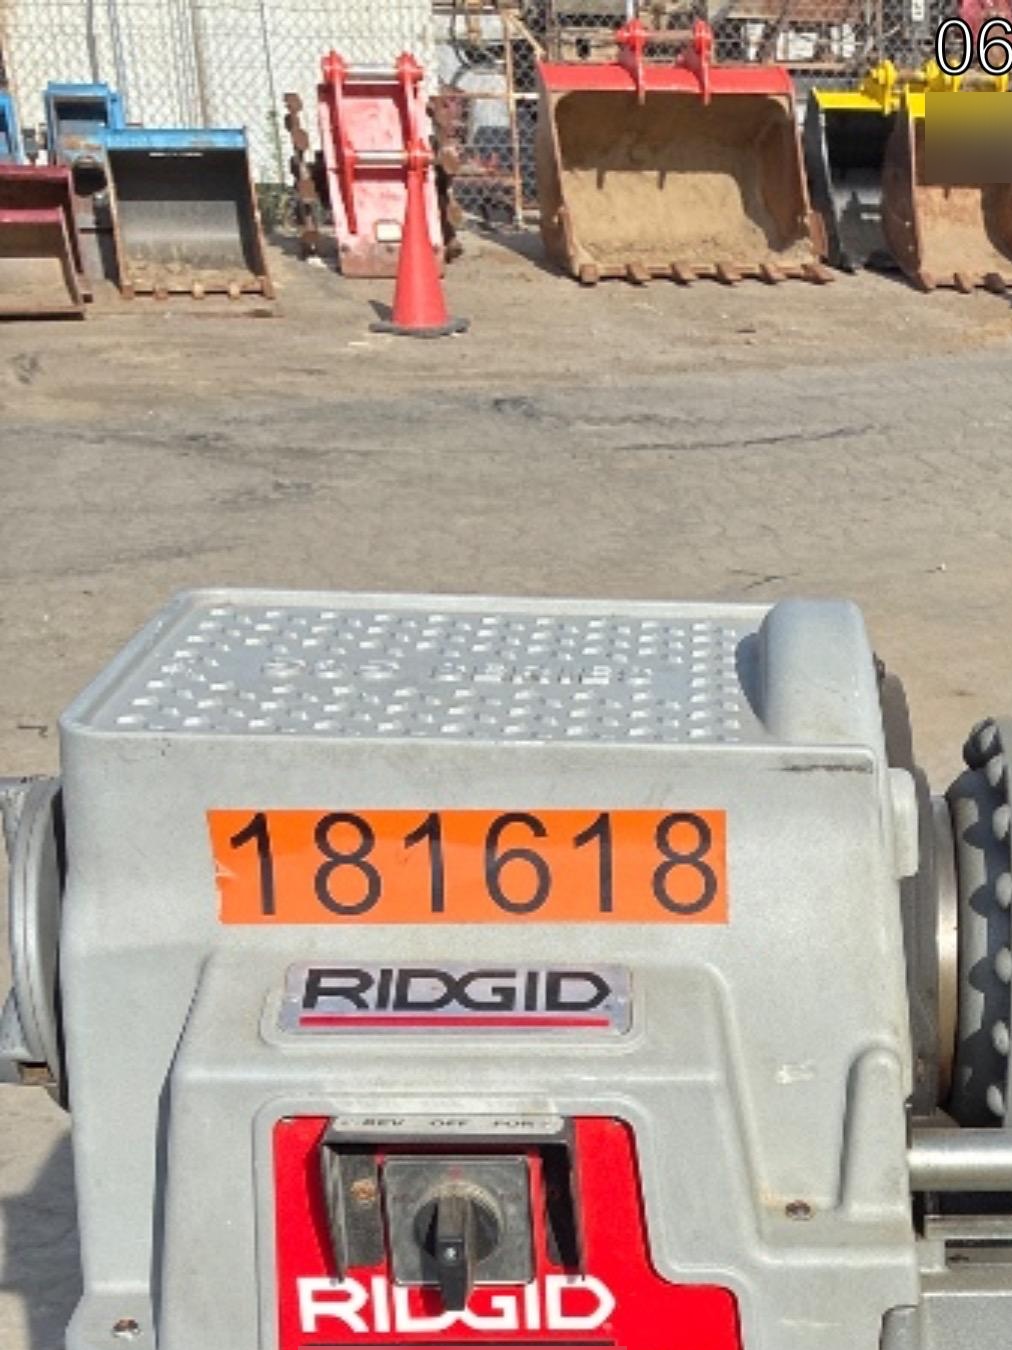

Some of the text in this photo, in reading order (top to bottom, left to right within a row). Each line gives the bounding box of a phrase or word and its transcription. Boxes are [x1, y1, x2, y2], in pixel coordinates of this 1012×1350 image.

[229, 811, 718, 916] 181618
[302, 967, 612, 1012] RIDGID
[362, 1117, 405, 1127] REV
[431, 1118, 470, 1128] OFF
[296, 1273, 616, 1334] RIDGID
